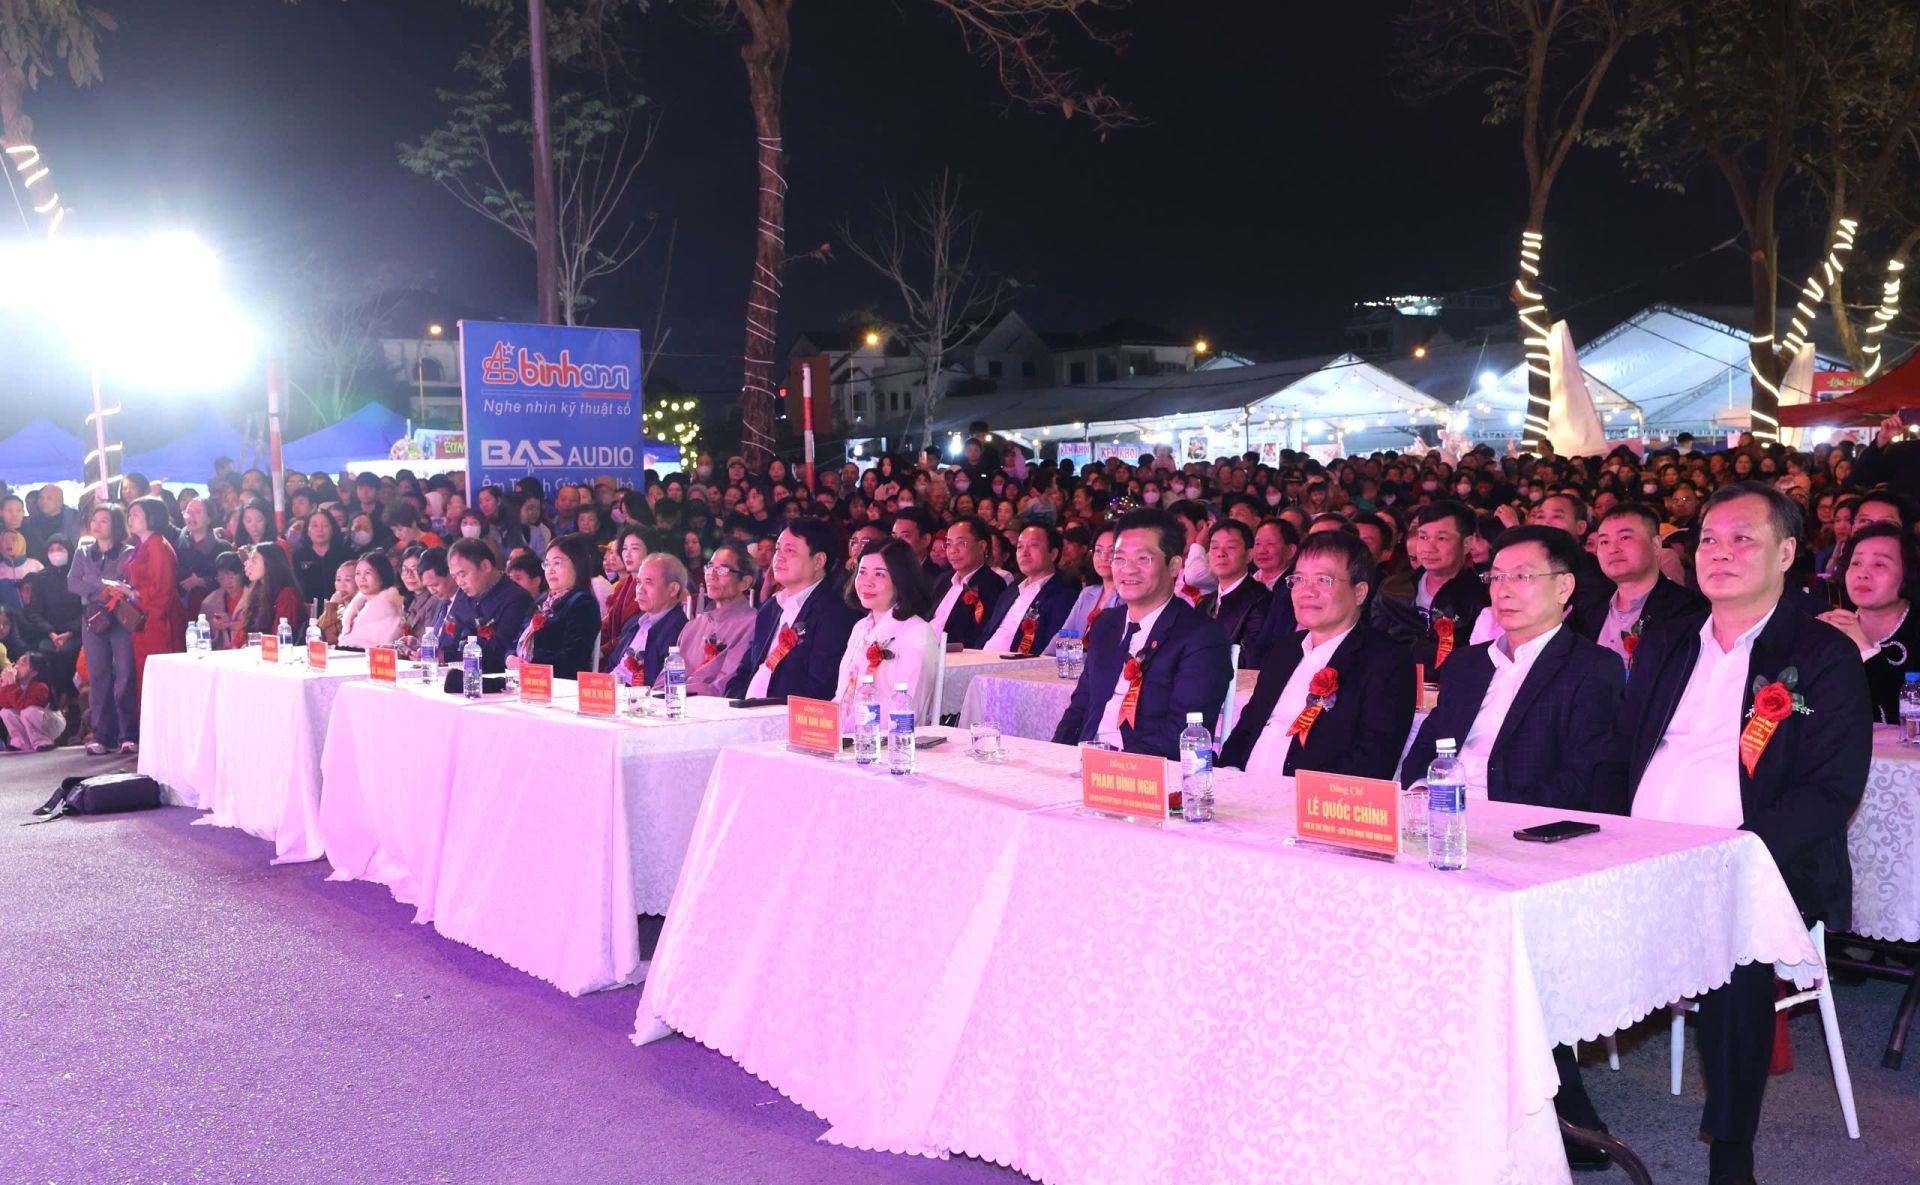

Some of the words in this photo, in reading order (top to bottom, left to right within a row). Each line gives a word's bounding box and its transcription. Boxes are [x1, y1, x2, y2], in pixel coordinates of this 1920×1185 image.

[483, 399, 521, 416] Nghe
[561, 401, 576, 417] kỹ
[580, 401, 613, 417] thuật
[616, 400, 631, 415] số
[481, 440, 564, 466] BAS
[567, 446, 634, 467] AUDIO
[1091, 772, 1114, 791] PHẠM
[1137, 779, 1158, 798] NGHỊ
[1307, 796, 1320, 816] LÊ
[1322, 798, 1350, 820] QUỐC
